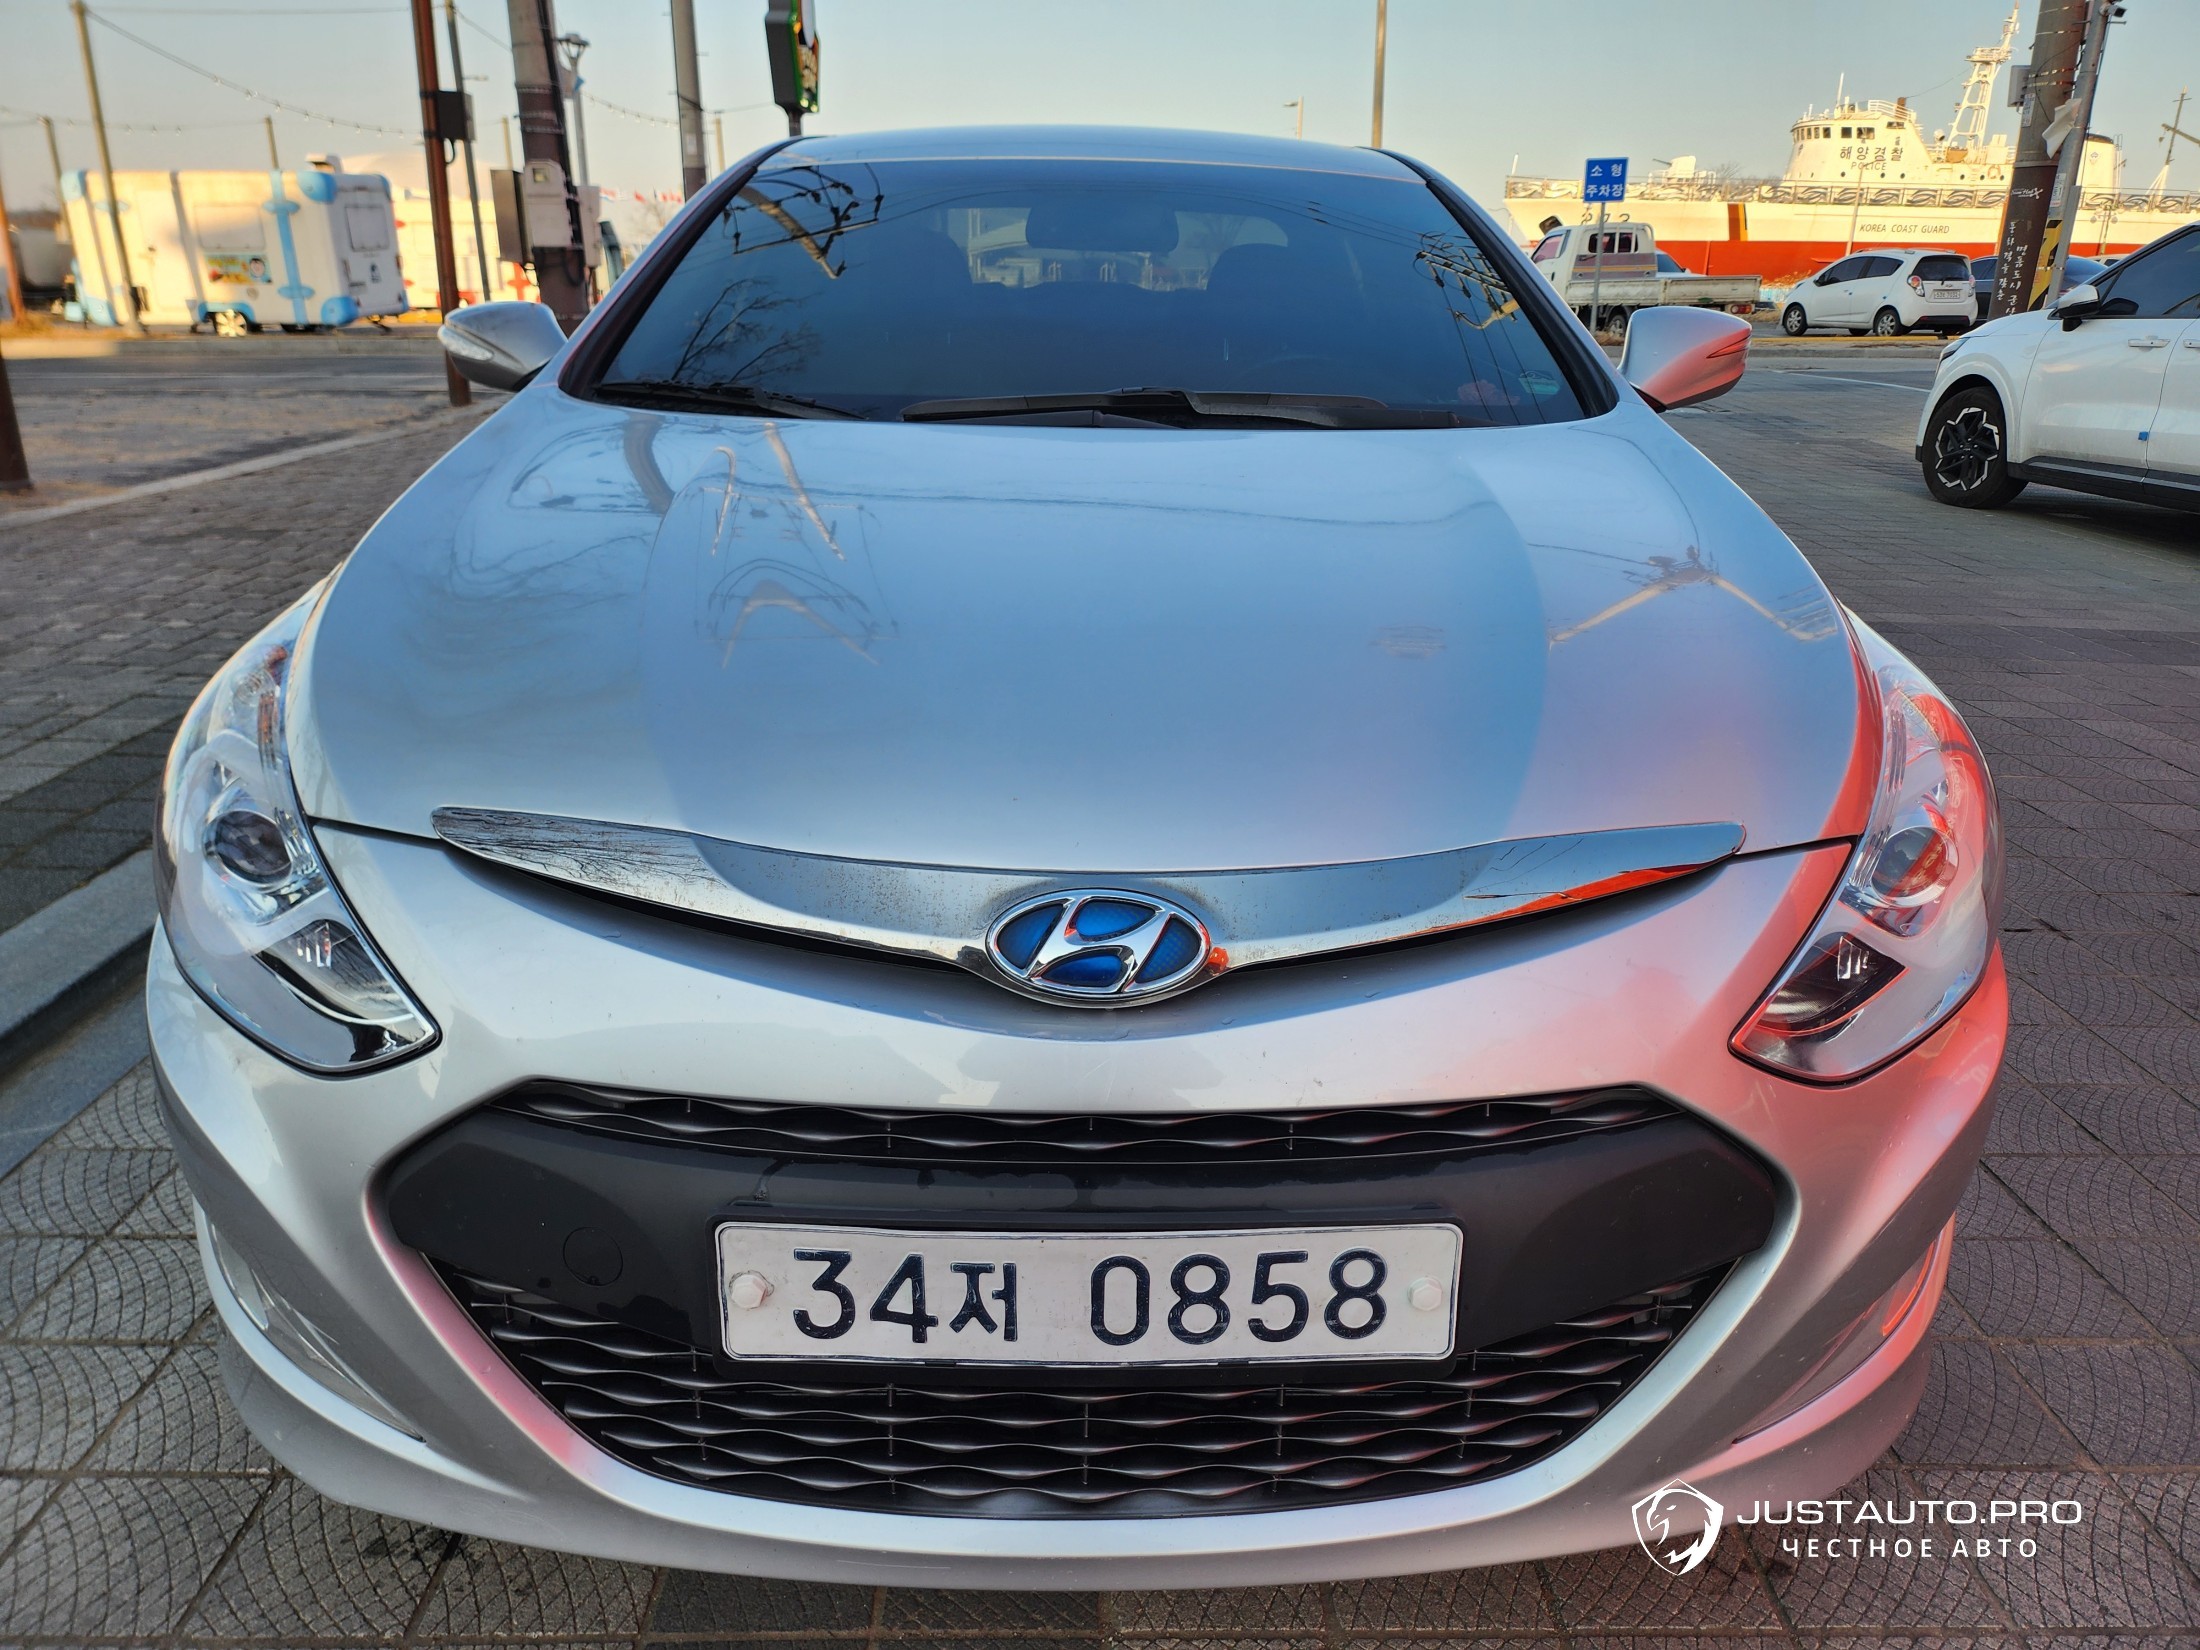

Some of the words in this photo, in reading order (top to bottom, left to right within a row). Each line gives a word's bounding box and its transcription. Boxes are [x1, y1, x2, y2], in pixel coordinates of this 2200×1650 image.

[1840, 146, 1903, 161] 해양경찰
[1851, 162, 1887, 171] POLICE
[1586, 184, 1624, 198] 주차장
[1859, 223, 1887, 232] KOREA
[1891, 223, 1918, 233] COAST
[1921, 224, 1950, 234] GUARD
[792, 1247, 1019, 1344] 34저
[1090, 1248, 1389, 1346] 0858
